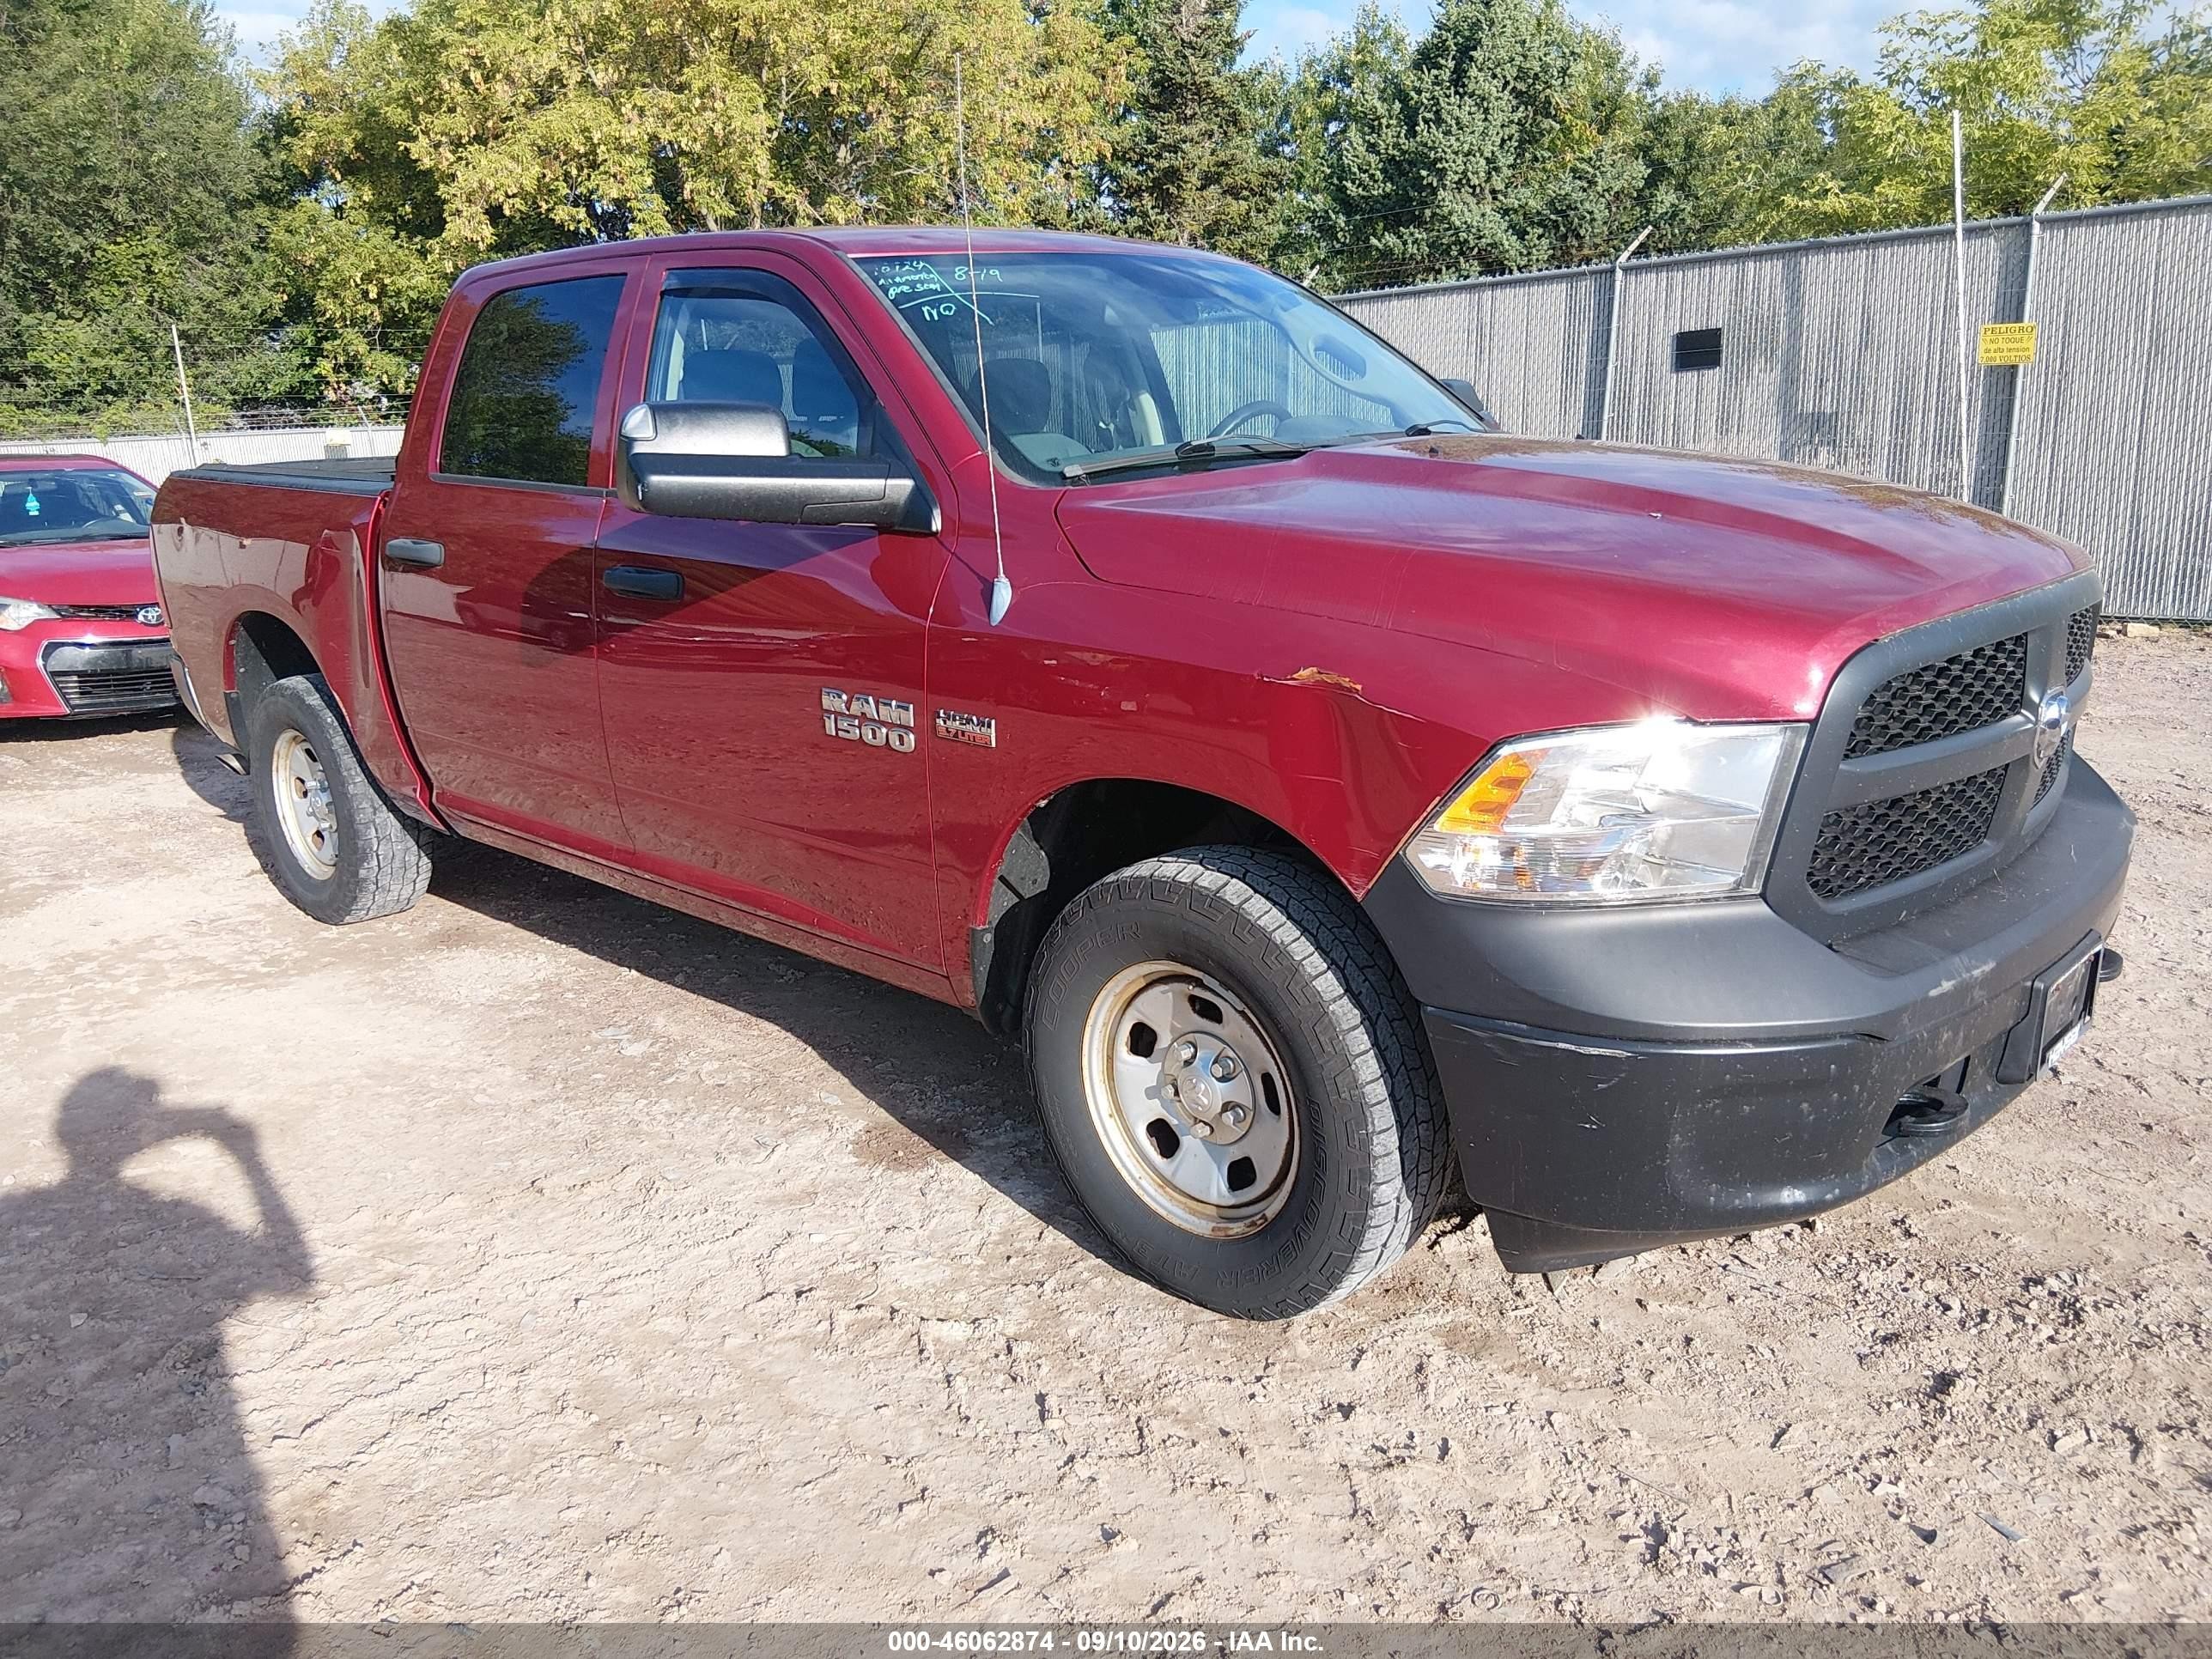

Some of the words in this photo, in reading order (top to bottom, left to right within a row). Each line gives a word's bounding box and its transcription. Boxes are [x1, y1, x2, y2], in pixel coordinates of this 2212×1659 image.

[954, 266, 1003, 282] 8-19
[1984, 325, 2033, 335] PELIGRO
[821, 687, 915, 727] RAM
[936, 708, 996, 734] HEMI
[823, 713, 915, 753] 1500
[938, 725, 955, 738] 5.7
[957, 730, 991, 744] LITER
[1042, 921, 1142, 1031] COOPER
[1216, 1095, 1328, 1288] DISCOVERER
